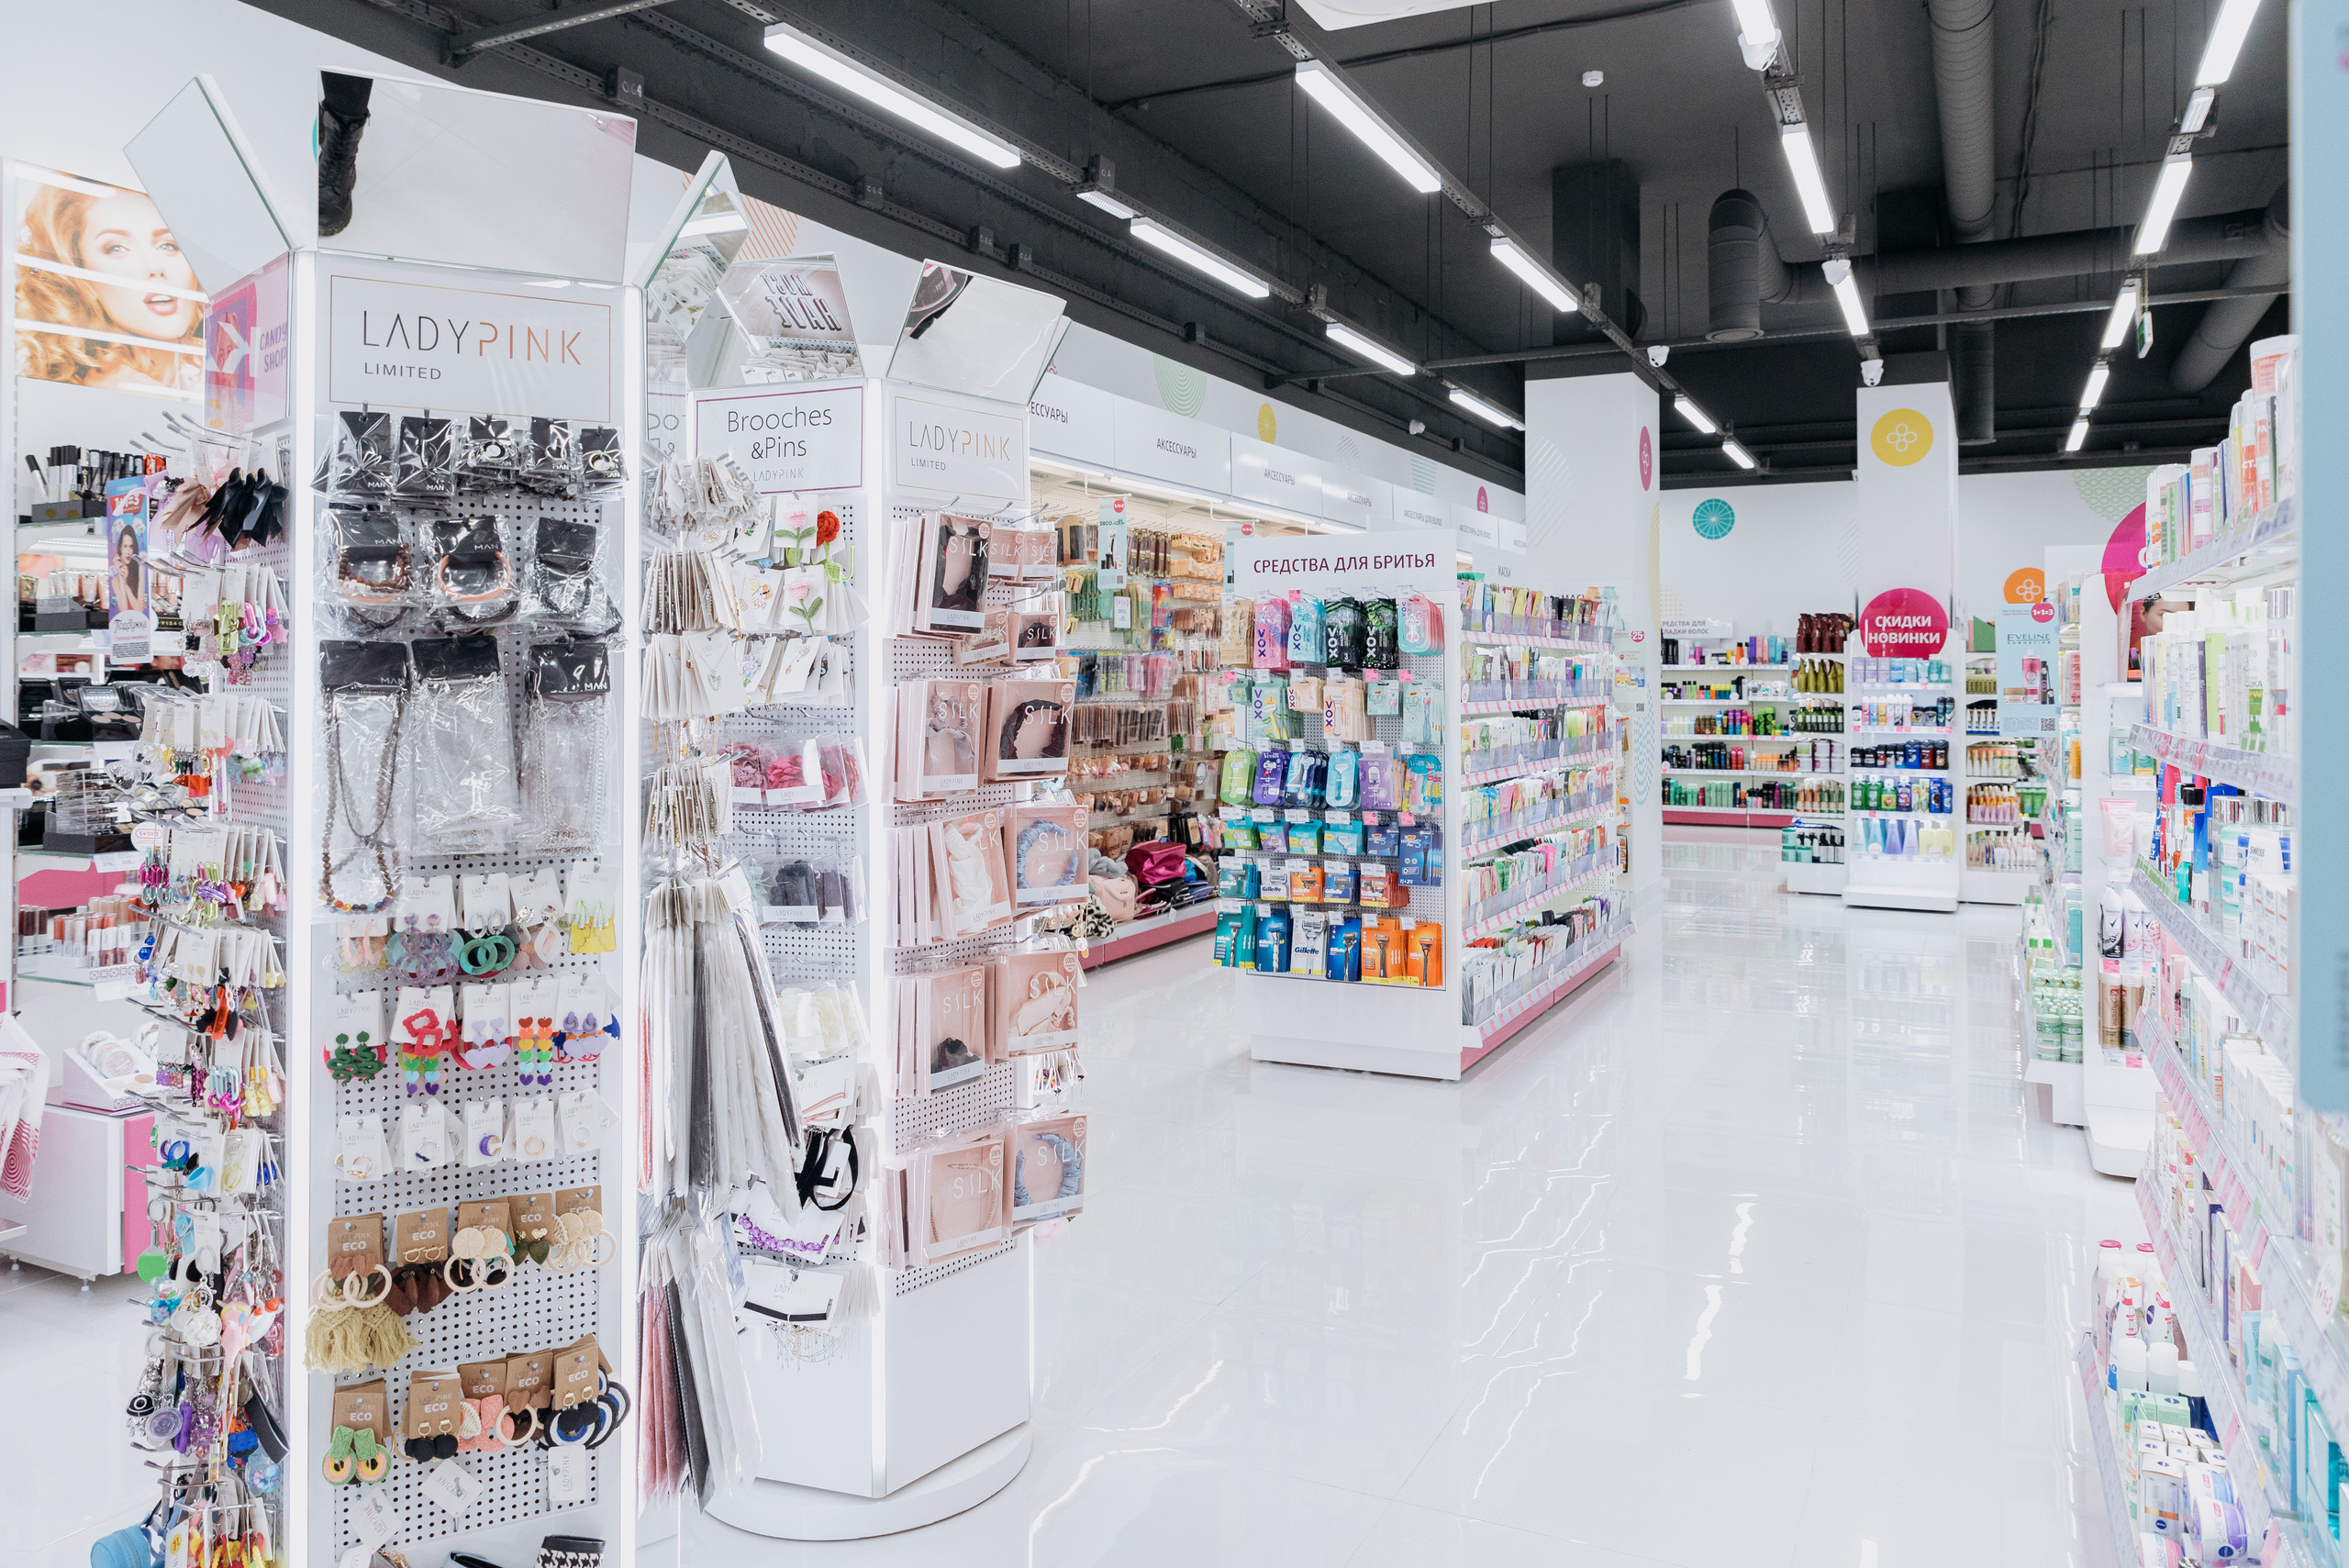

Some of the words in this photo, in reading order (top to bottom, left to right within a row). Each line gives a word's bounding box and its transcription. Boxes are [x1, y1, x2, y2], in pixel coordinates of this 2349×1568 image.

[259, 321, 288, 351] CANDY
[362, 310, 583, 366] LADYPINK
[263, 348, 287, 373] SHOP
[364, 362, 441, 380] LIMITED
[728, 406, 832, 433] Brooches
[1029, 404, 1068, 425] ЕССУАРЫ
[751, 436, 807, 460] &Pins
[909, 420, 1010, 462] LADYPINK
[1156, 436, 1197, 460] АКСЕССУАРЫ
[911, 459, 947, 471] LIMITED
[752, 468, 804, 483] LADYPINK
[1264, 467, 1296, 487] АКСЕССУАРЫ
[949, 537, 989, 558] SILK
[990, 542, 1022, 558] SILK
[1030, 543, 1056, 558] SILK
[1253, 557, 1330, 575] СРЕДСТВА
[1334, 556, 1368, 573] ДЛЯ
[1373, 553, 1435, 570] БРИТЬЯ
[1497, 565, 1511, 578] МАСКИ
[2032, 608, 2054, 617] 1+1=3
[1222, 608, 1233, 643] VOX
[1875, 615, 1932, 628] СКИДКИ
[1026, 626, 1056, 640] SILK
[1293, 624, 1302, 651] VOX
[1868, 632, 1941, 644] НОВИНКИ
[2007, 633, 2051, 641] EVELINE
[1257, 629, 1266, 657] VOX
[1328, 627, 1339, 658] VOX
[1366, 626, 1377, 658] VOX
[381, 676, 406, 684] MAN
[584, 682, 608, 690] MAN
[1063, 686, 1074, 695] 100%
[938, 702, 979, 719] SILK
[1253, 689, 1263, 719] VOX
[1023, 705, 1073, 725] SILK
[1325, 701, 1333, 727] VOX
[1038, 830, 1087, 852] SILK
[2249, 846, 2266, 858] SWISS
[1294, 947, 1319, 955] Gillette
[1030, 974, 1076, 998] SILK
[943, 988, 983, 1014] SILK
[1074, 1120, 1085, 1129] 100%
[1037, 1140, 1085, 1167] SILK
[953, 1168, 1001, 1199] SILK
[520, 1212, 542, 1223] ECO
[412, 1229, 436, 1241] ECO
[342, 1240, 367, 1251] ECO
[774, 1284, 807, 1297] LADYPINK
[518, 1376, 540, 1387] ECO
[568, 1370, 589, 1382] ECO
[473, 1384, 495, 1394] ECO
[424, 1402, 449, 1413] ECO
[350, 1411, 373, 1422] ECO
